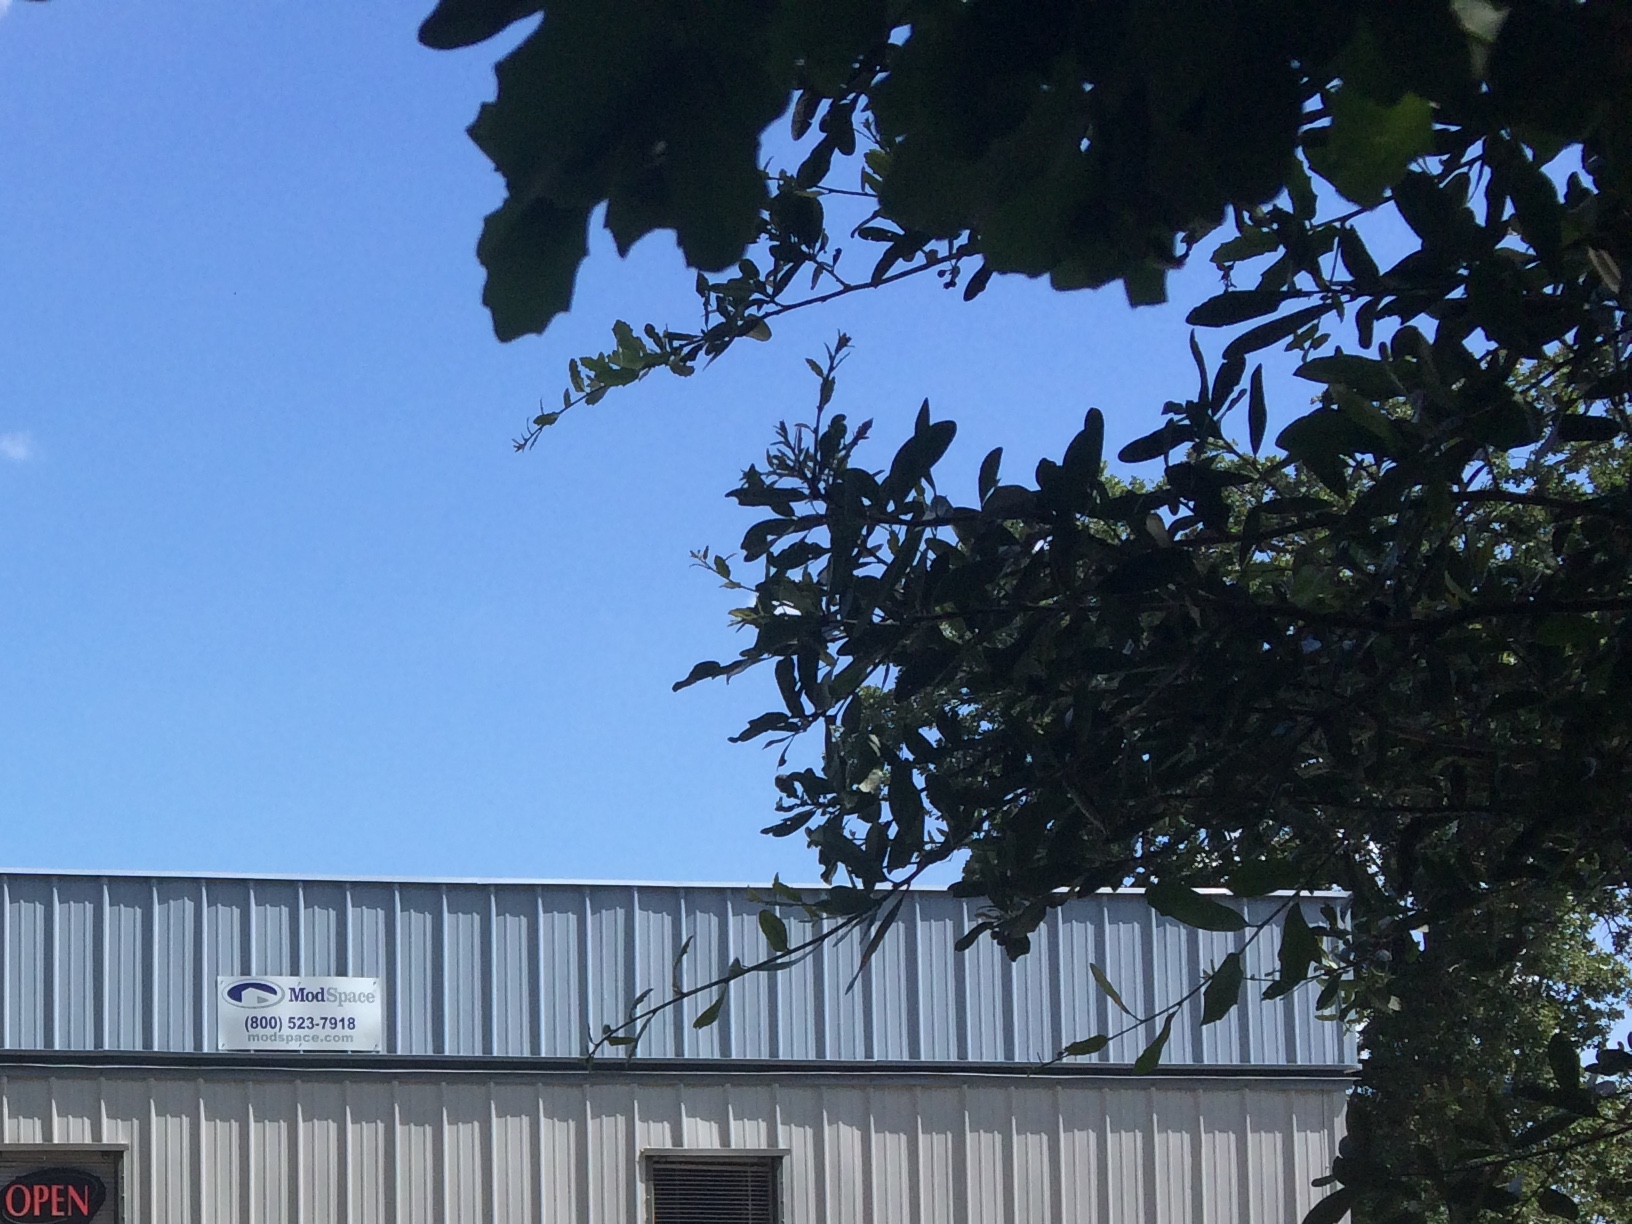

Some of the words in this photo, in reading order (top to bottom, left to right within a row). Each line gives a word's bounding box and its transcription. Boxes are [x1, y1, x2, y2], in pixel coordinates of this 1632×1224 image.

[288, 987, 375, 1007] ModSpace
[244, 1015, 283, 1032] (800)
[287, 1016, 356, 1030] 523-7918
[247, 1032, 354, 1044] modspace.com
[5, 1184, 90, 1217] OPEN
